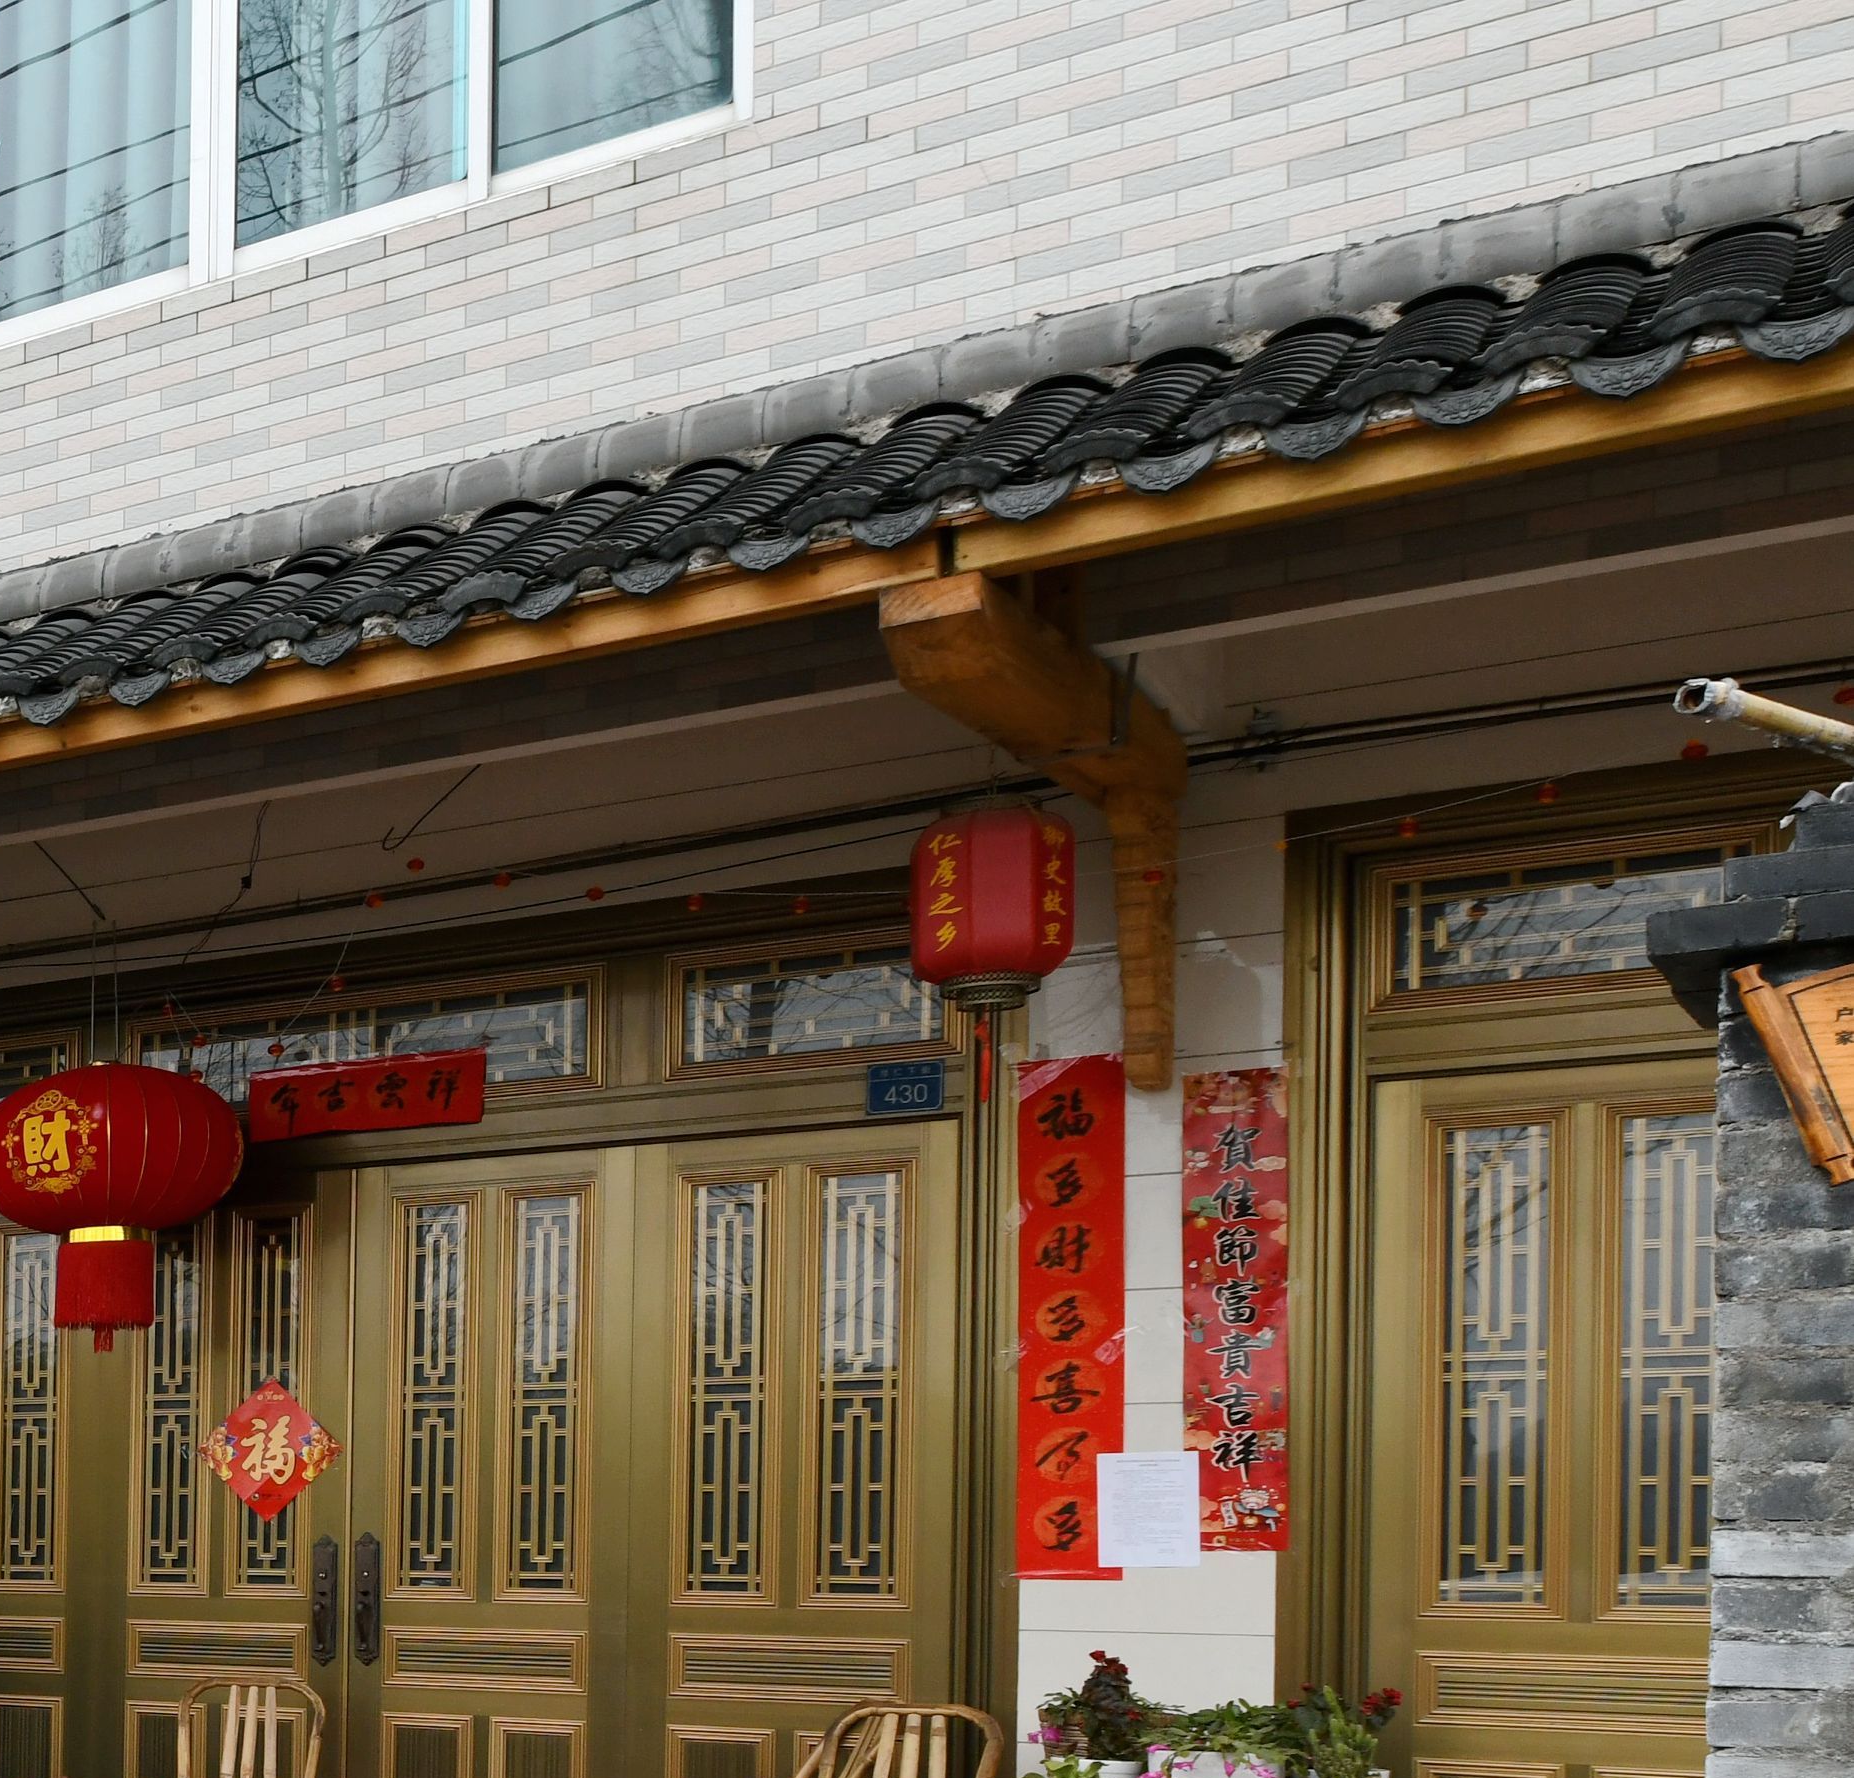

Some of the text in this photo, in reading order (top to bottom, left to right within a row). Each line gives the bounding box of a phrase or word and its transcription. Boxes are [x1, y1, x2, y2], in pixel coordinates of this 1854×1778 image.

[883, 1083, 928, 1105] 430
[22, 1109, 71, 1177] 財
[1205, 1123, 1263, 1483] 賀佳節富貴吉祥
[241, 1415, 295, 1485] 福
